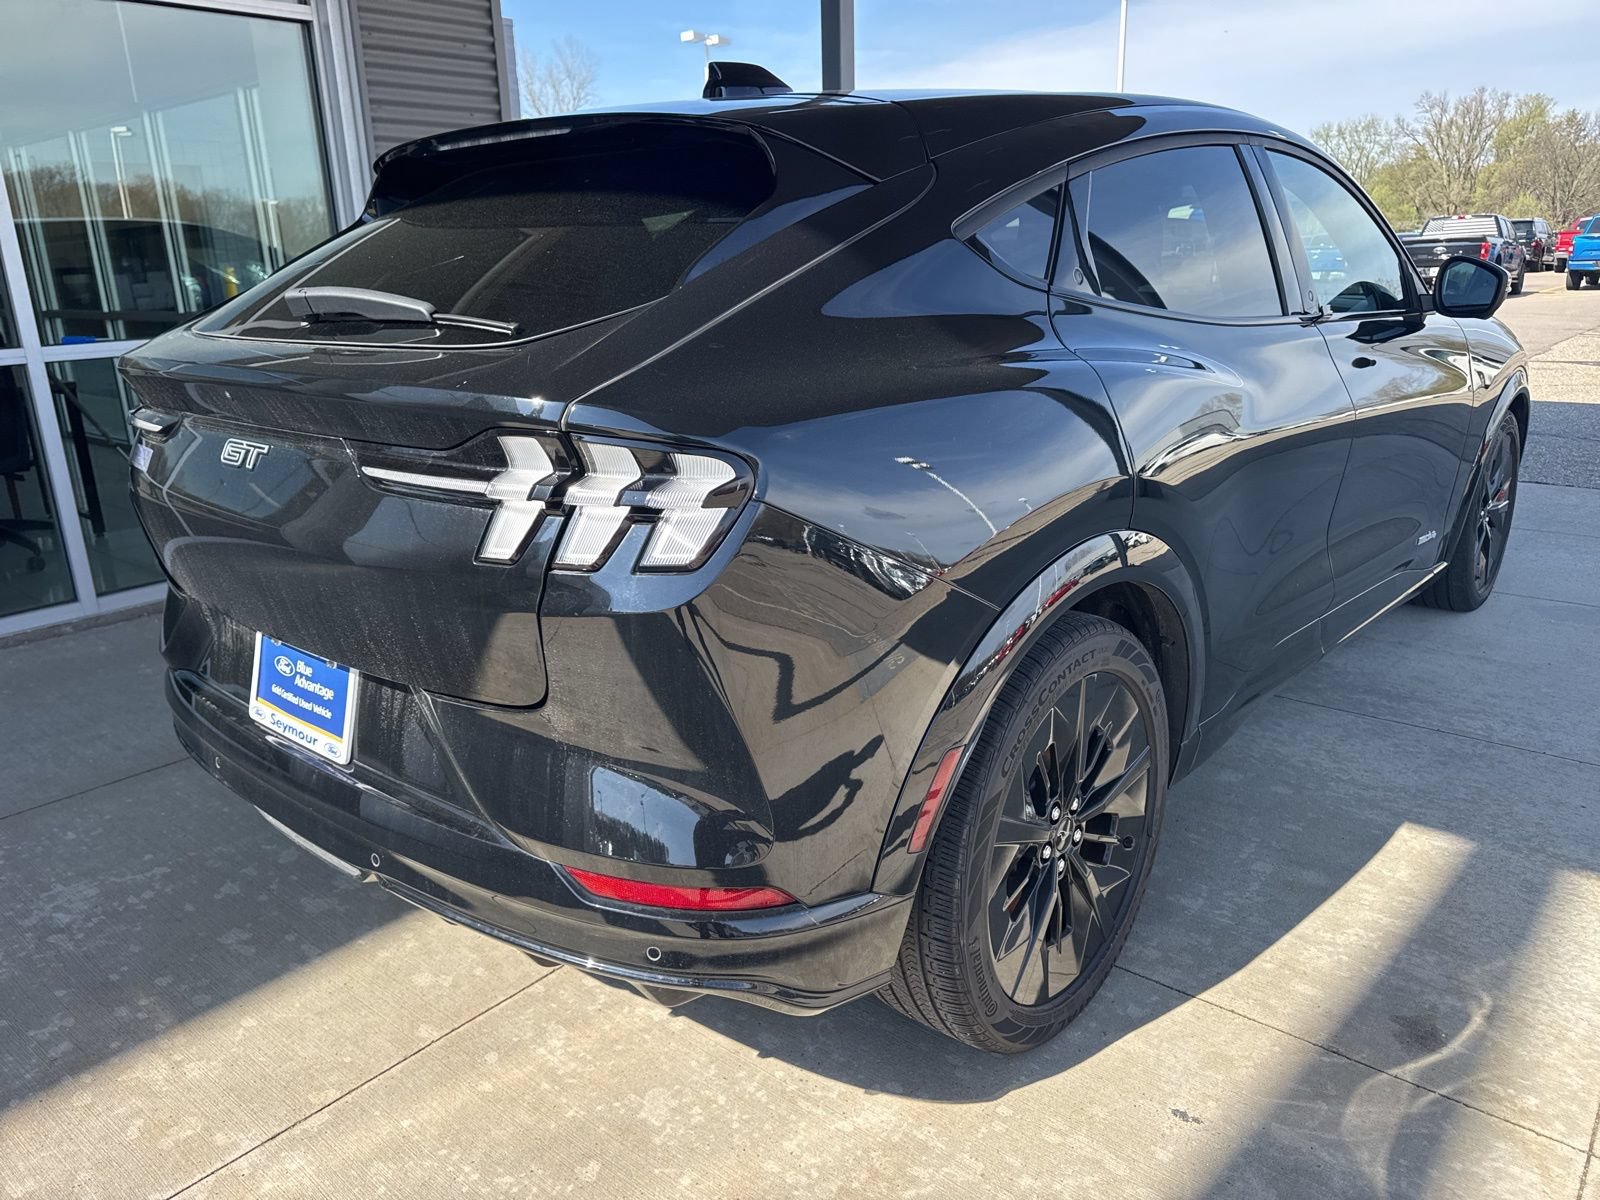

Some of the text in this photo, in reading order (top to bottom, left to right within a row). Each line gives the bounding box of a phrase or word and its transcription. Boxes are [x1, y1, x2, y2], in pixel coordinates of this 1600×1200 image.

[220, 438, 270, 469] GT
[296, 659, 313, 677] Blue
[294, 674, 335, 701] Advantage
[312, 703, 332, 719] Vehicle
[270, 712, 318, 746] Seymour
